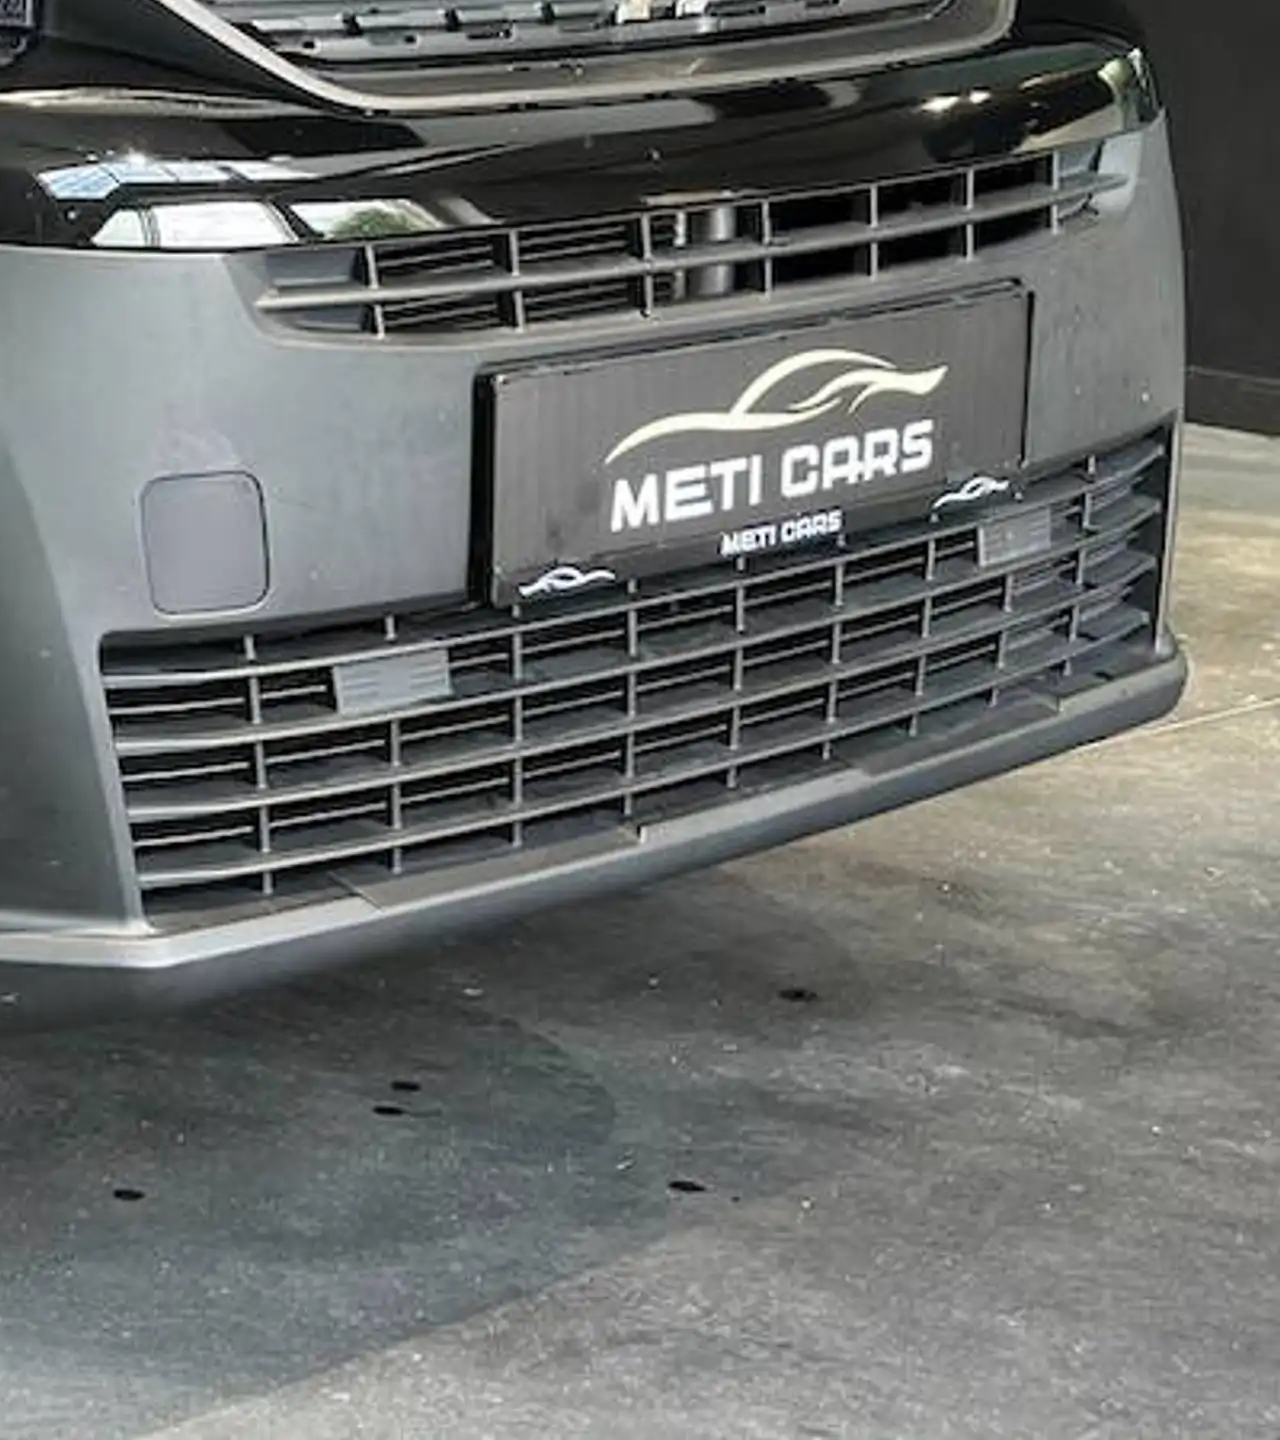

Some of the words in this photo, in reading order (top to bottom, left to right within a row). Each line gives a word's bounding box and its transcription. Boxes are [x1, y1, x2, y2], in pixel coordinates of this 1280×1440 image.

[610, 454, 763, 534] METI
[781, 418, 935, 498] CARS
[721, 524, 776, 557] METI
[781, 509, 843, 545] CARS
